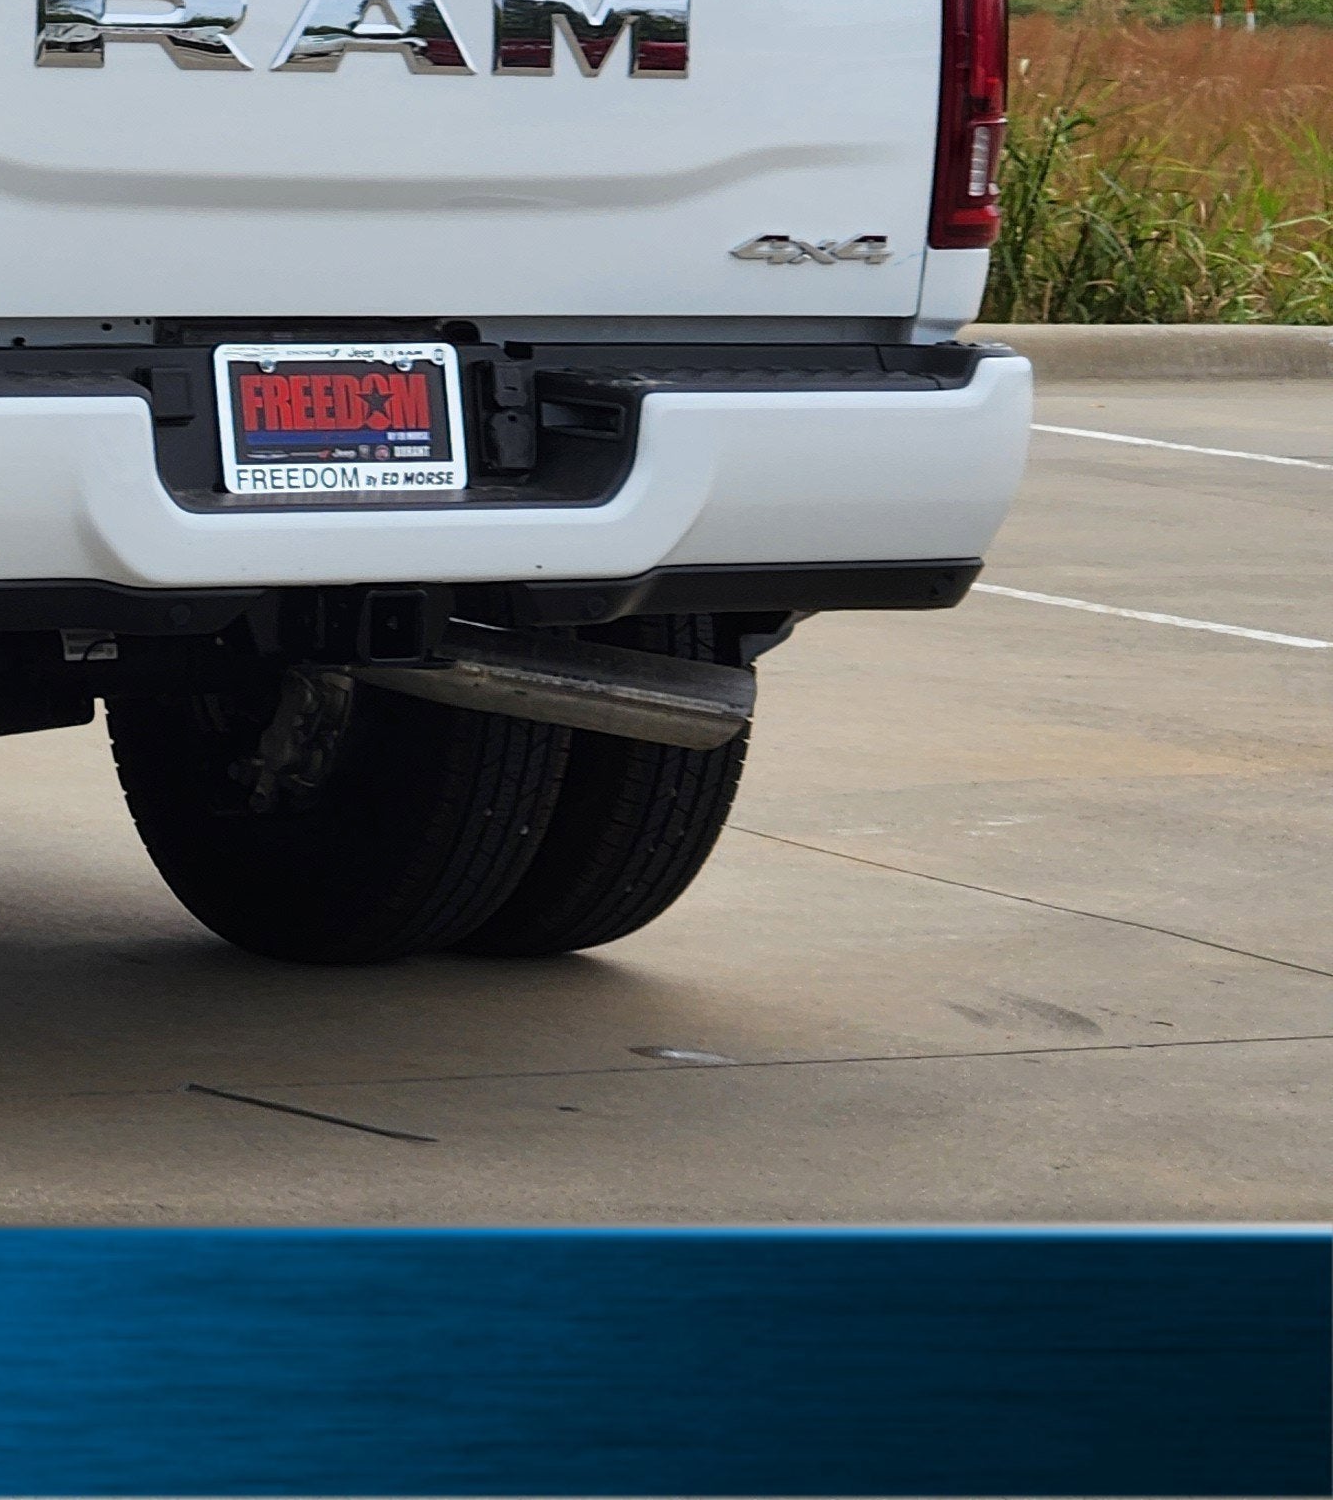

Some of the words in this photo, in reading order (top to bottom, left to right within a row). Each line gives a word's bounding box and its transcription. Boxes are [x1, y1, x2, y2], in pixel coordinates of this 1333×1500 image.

[728, 233, 894, 265] 4x4
[239, 373, 431, 431] FREEDOM
[237, 467, 359, 490] FREEDOM
[381, 472, 399, 485] ED
[403, 471, 454, 485] MORSE
